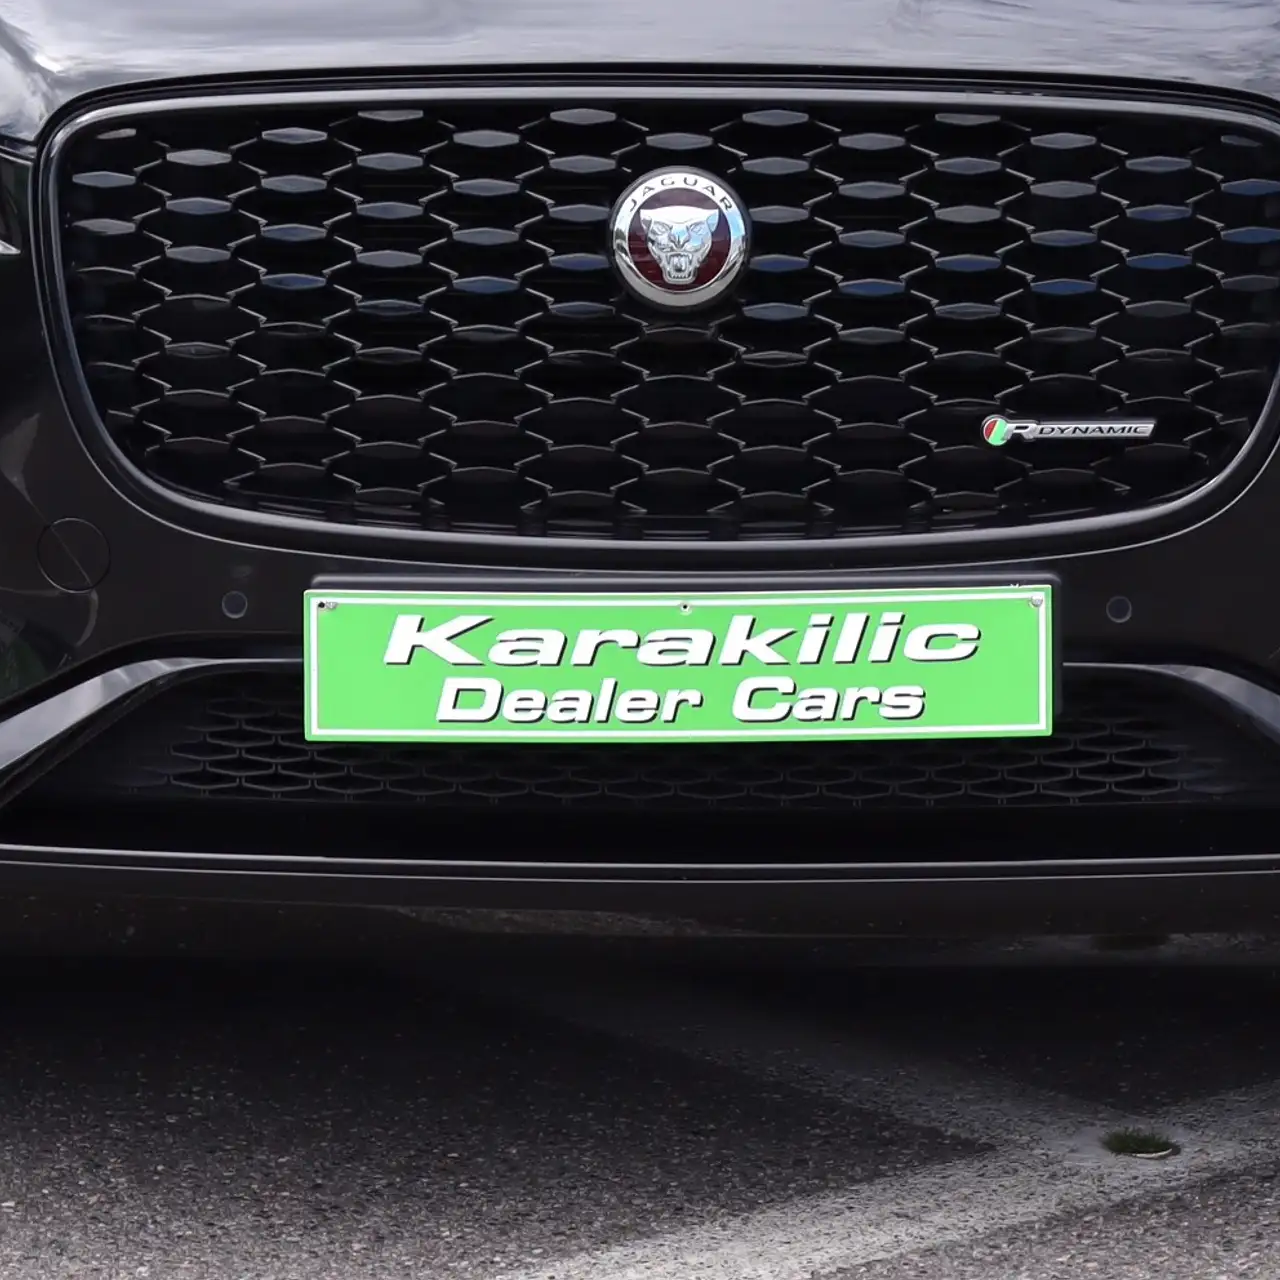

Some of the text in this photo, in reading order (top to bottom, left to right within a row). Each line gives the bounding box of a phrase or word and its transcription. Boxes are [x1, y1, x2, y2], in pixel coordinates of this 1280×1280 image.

[629, 177, 733, 212] JAGUAR
[382, 611, 982, 666] Karakilic
[435, 675, 926, 724] Dealer Cars
